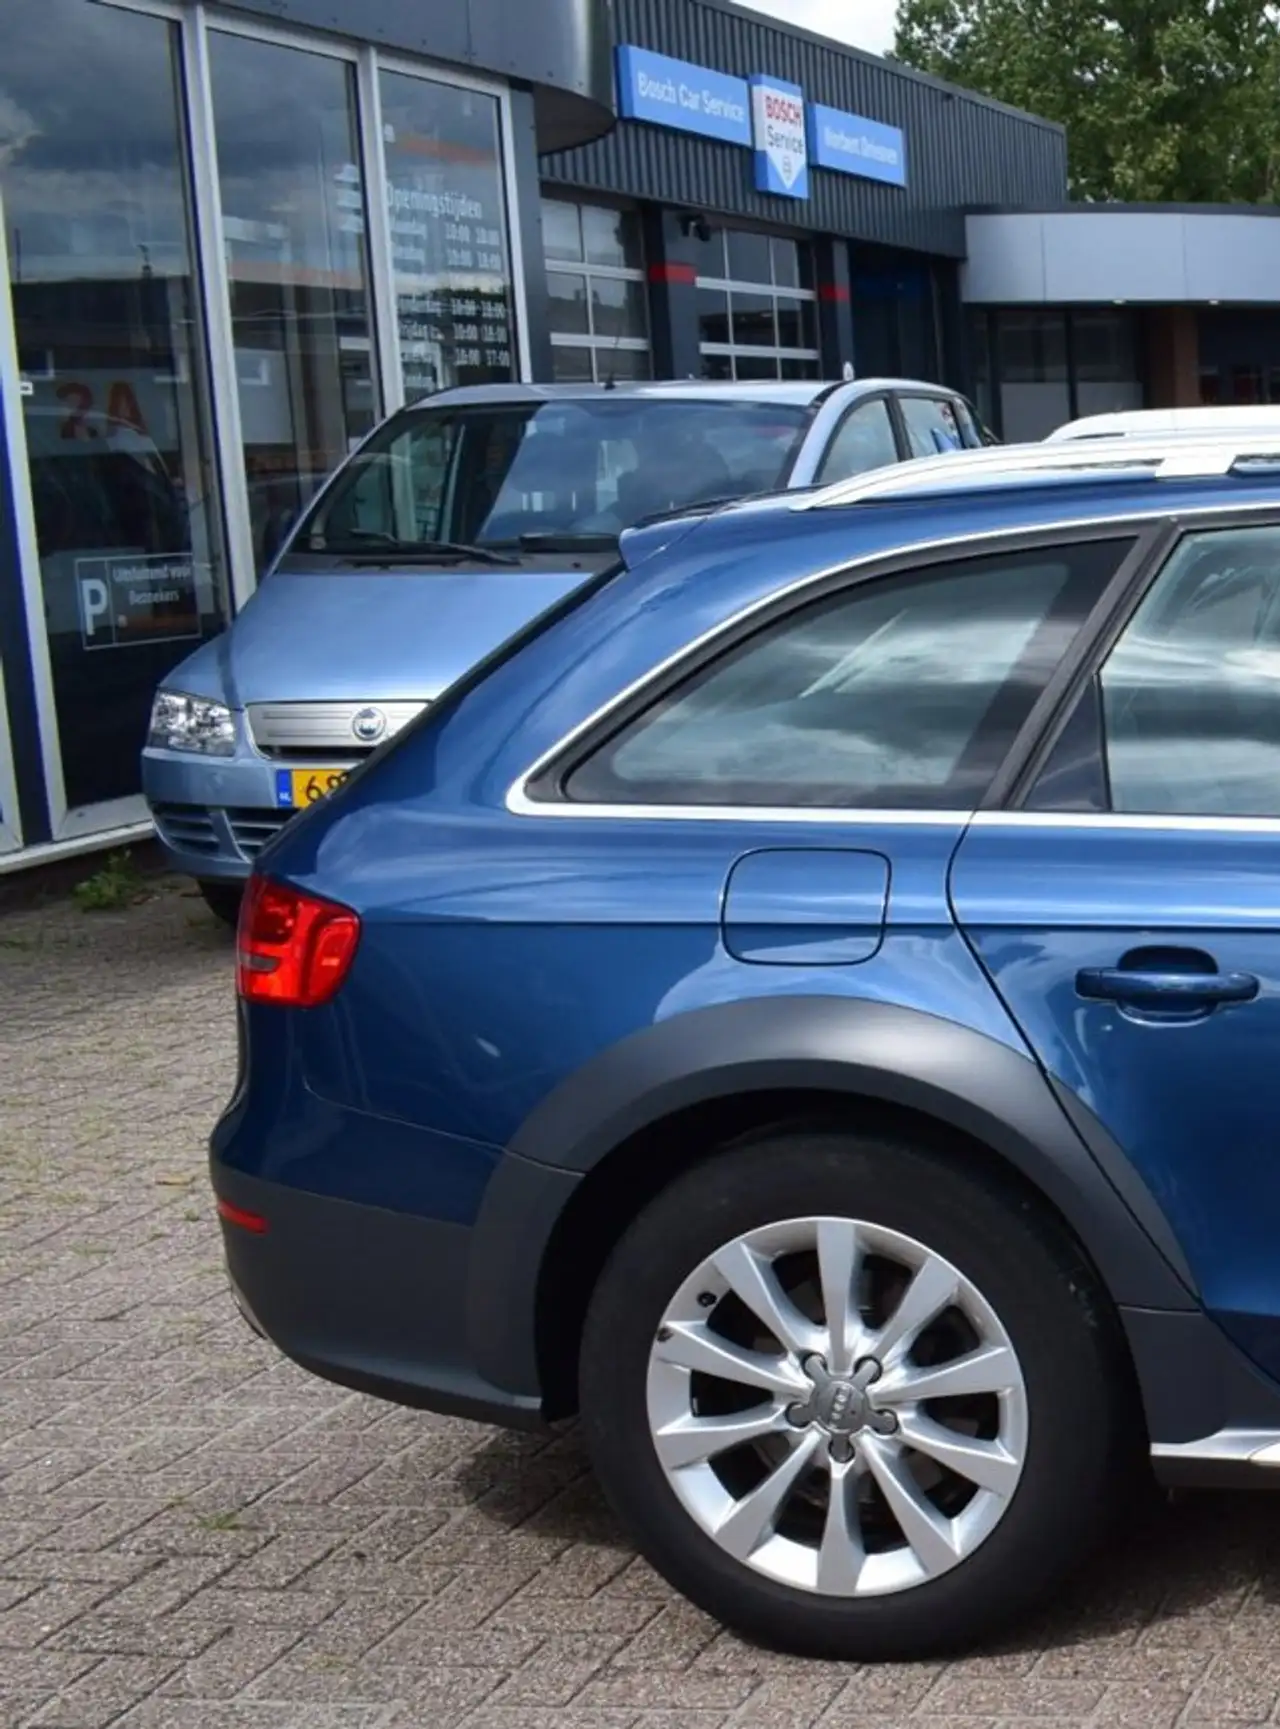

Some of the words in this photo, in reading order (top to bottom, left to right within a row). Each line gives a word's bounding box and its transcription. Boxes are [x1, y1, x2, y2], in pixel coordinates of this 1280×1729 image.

[637, 70, 677, 104] Bosch
[679, 84, 700, 110] Car
[702, 89, 744, 123] Service
[765, 95, 801, 126] BOSCH
[767, 124, 804, 154] Service
[81, 578, 108, 635] P
